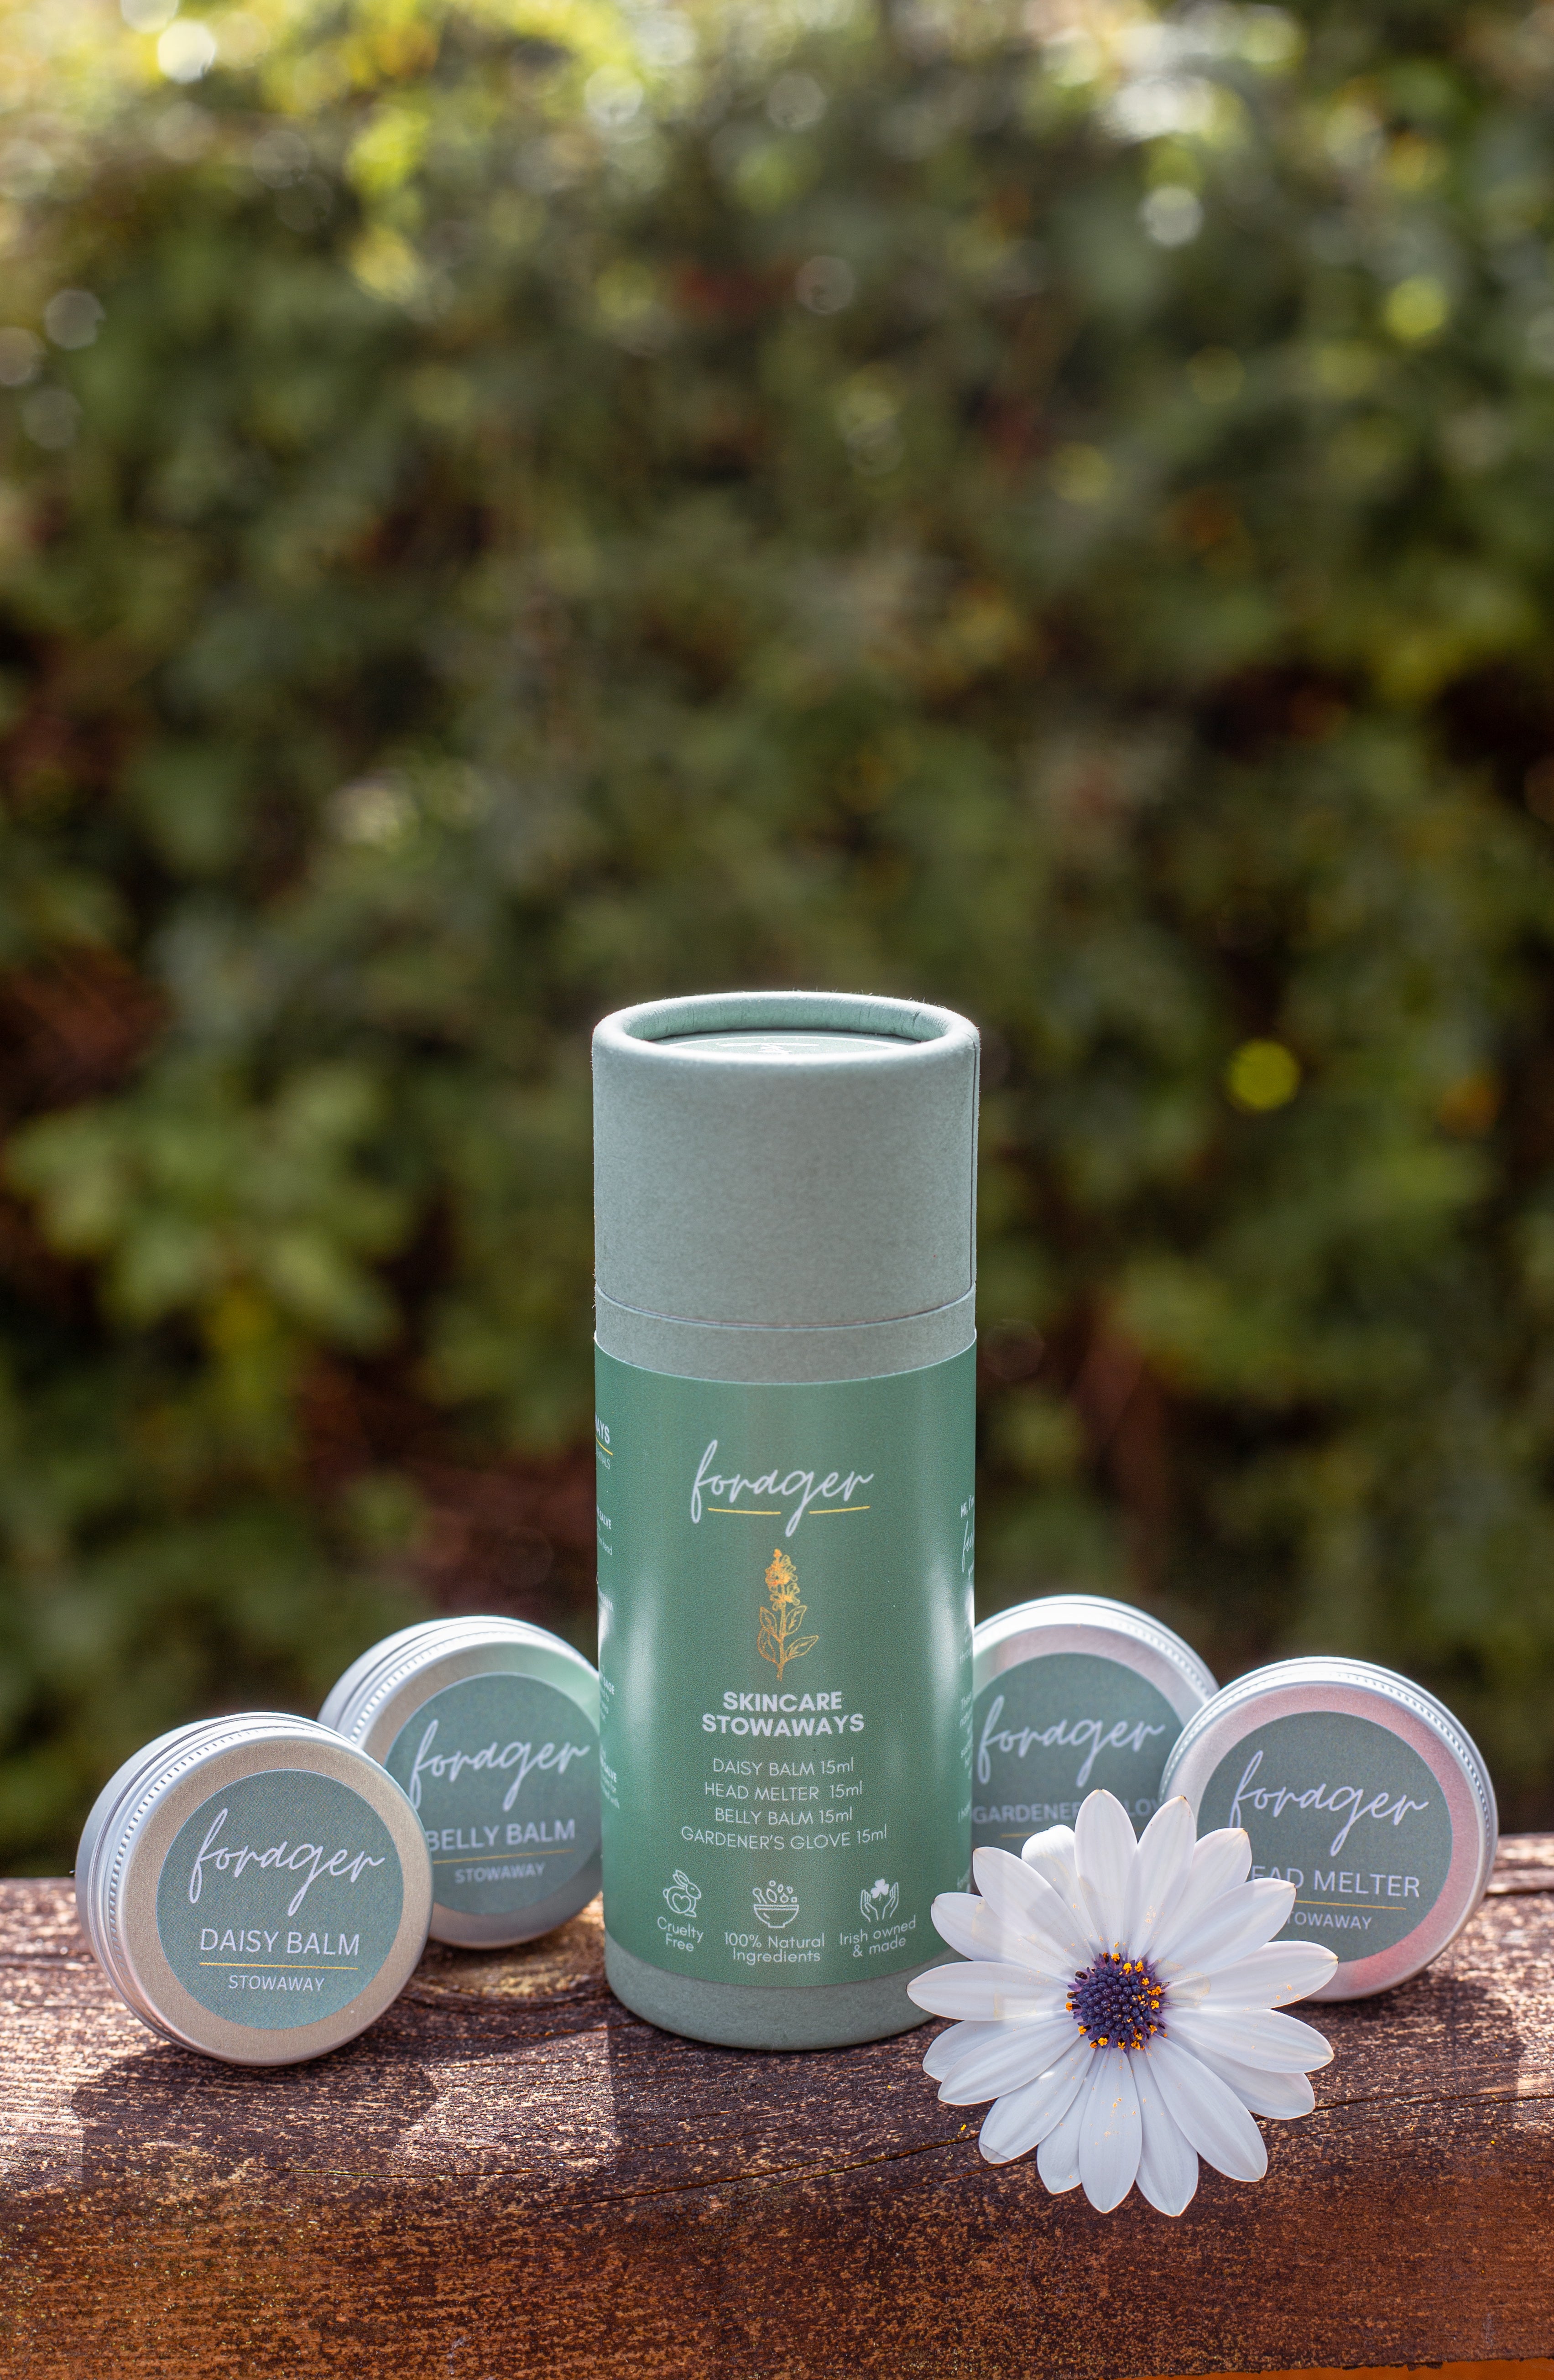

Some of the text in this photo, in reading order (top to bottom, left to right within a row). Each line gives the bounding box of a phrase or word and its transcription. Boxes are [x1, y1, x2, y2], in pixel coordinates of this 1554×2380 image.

[690, 1439, 874, 1537] forager
[723, 1691, 842, 1713] SKINCARE
[702, 1713, 864, 1737] STOWAWAYS
[977, 1695, 1166, 1787] forager
[409, 1719, 590, 1812] forager
[713, 1756, 854, 1776] DAISY BALM 15ml
[705, 1780, 863, 1802] HEAD MELTER 15ml
[1229, 1750, 1429, 1857] forager
[715, 1807, 852, 1825] BELLY BALM 15ml
[426, 1819, 575, 1852] BELLY BALM
[681, 1824, 887, 1850] GARDENER'S GLOVE 15ml
[189, 1807, 386, 1916] forager
[455, 1863, 545, 1884] STOWAWAY
[1251, 1865, 1420, 1898] EAD MELTER
[657, 1916, 704, 1943] Cruelty
[839, 1916, 916, 1946] Irish owned
[1286, 1911, 1372, 1930] TOWAWAY
[200, 1928, 360, 1956] DAISY BALM
[666, 1933, 694, 1953] Free
[725, 1932, 825, 1949] 100% Natural
[852, 1935, 907, 1958] & made
[733, 1948, 821, 1966] Ingredients
[229, 1974, 325, 1992] STOWAWAY
